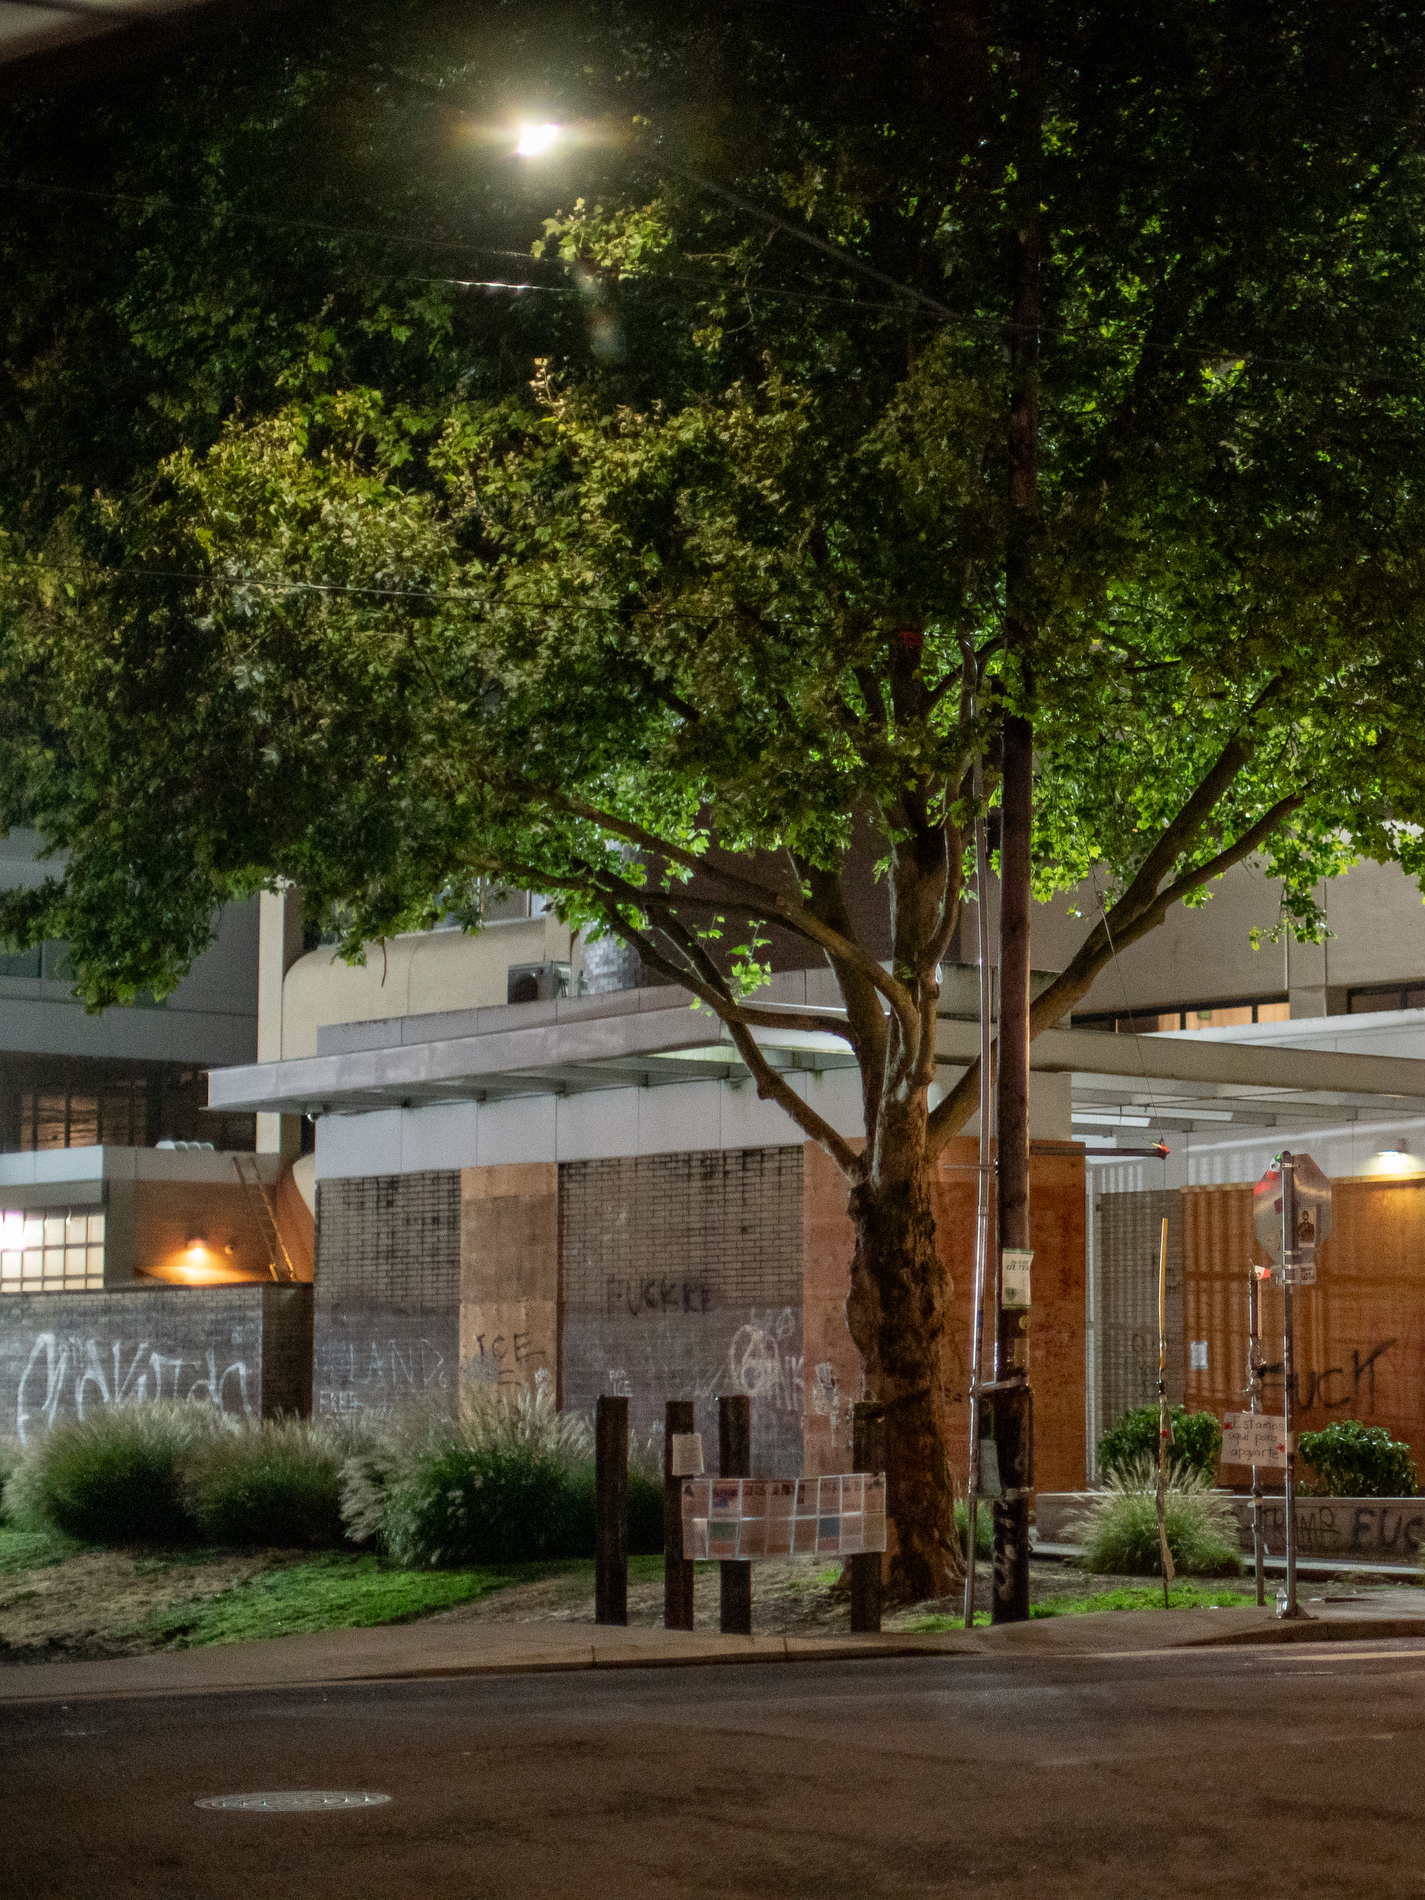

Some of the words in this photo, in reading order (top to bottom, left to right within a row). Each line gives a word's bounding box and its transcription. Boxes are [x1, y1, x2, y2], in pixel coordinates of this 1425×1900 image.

[477, 1332, 546, 1364] ICE
[1232, 1415, 1285, 1431] Estamos
[1255, 1433, 1277, 1446] para
[1230, 1447, 1279, 1461] apoyarte
[1259, 1506, 1342, 1542] TRMP
